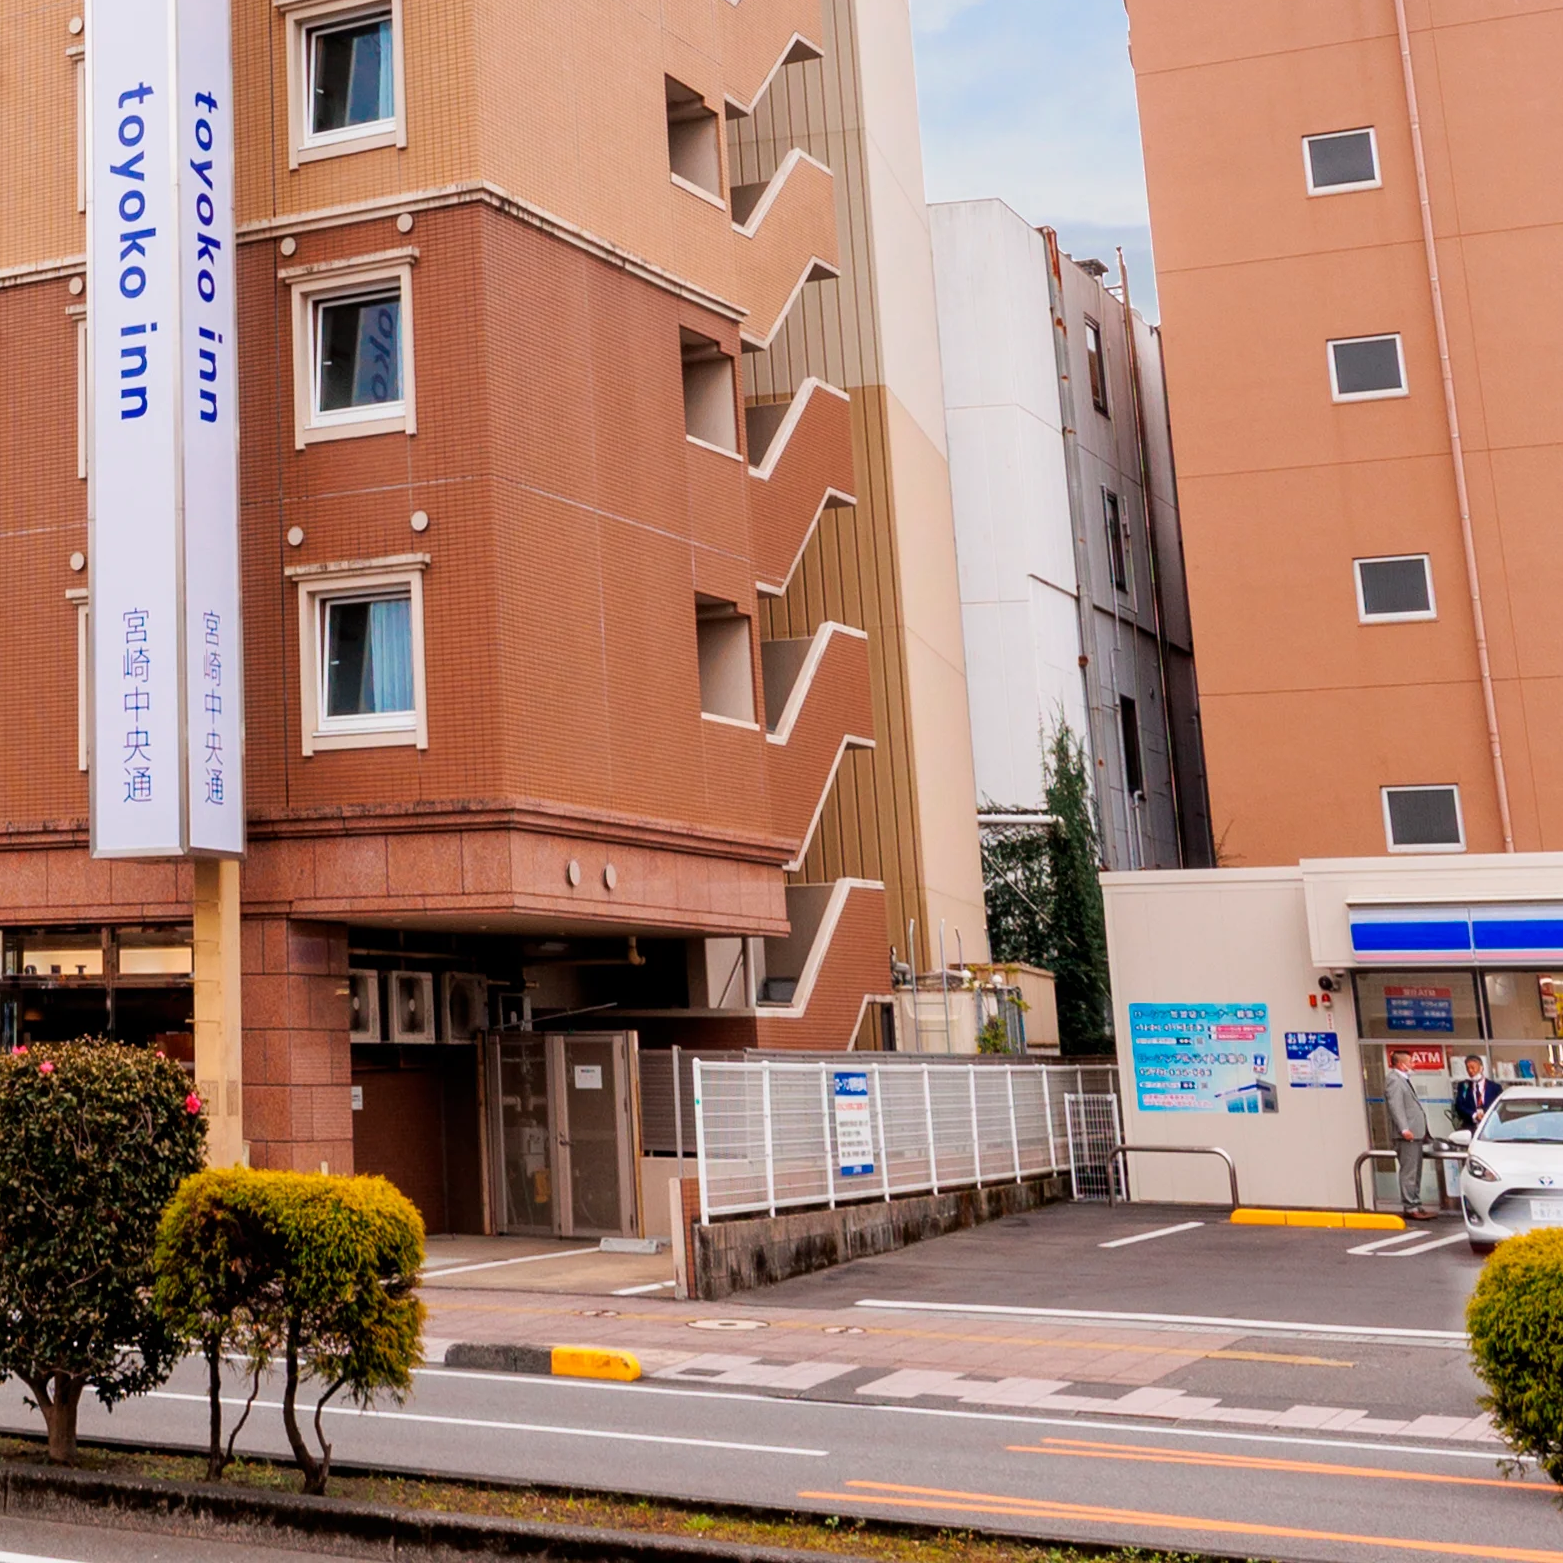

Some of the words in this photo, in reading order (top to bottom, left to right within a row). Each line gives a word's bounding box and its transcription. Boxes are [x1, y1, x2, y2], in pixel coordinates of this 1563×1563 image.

[109, 81, 157, 299] toyoko
[190, 90, 222, 303] toyoko
[120, 321, 158, 421] inn
[198, 326, 223, 424] inn
[122, 607, 153, 803] 宮崎中央通
[203, 610, 225, 806] 宮崎中央通
[1411, 1051, 1441, 1063] ATM
